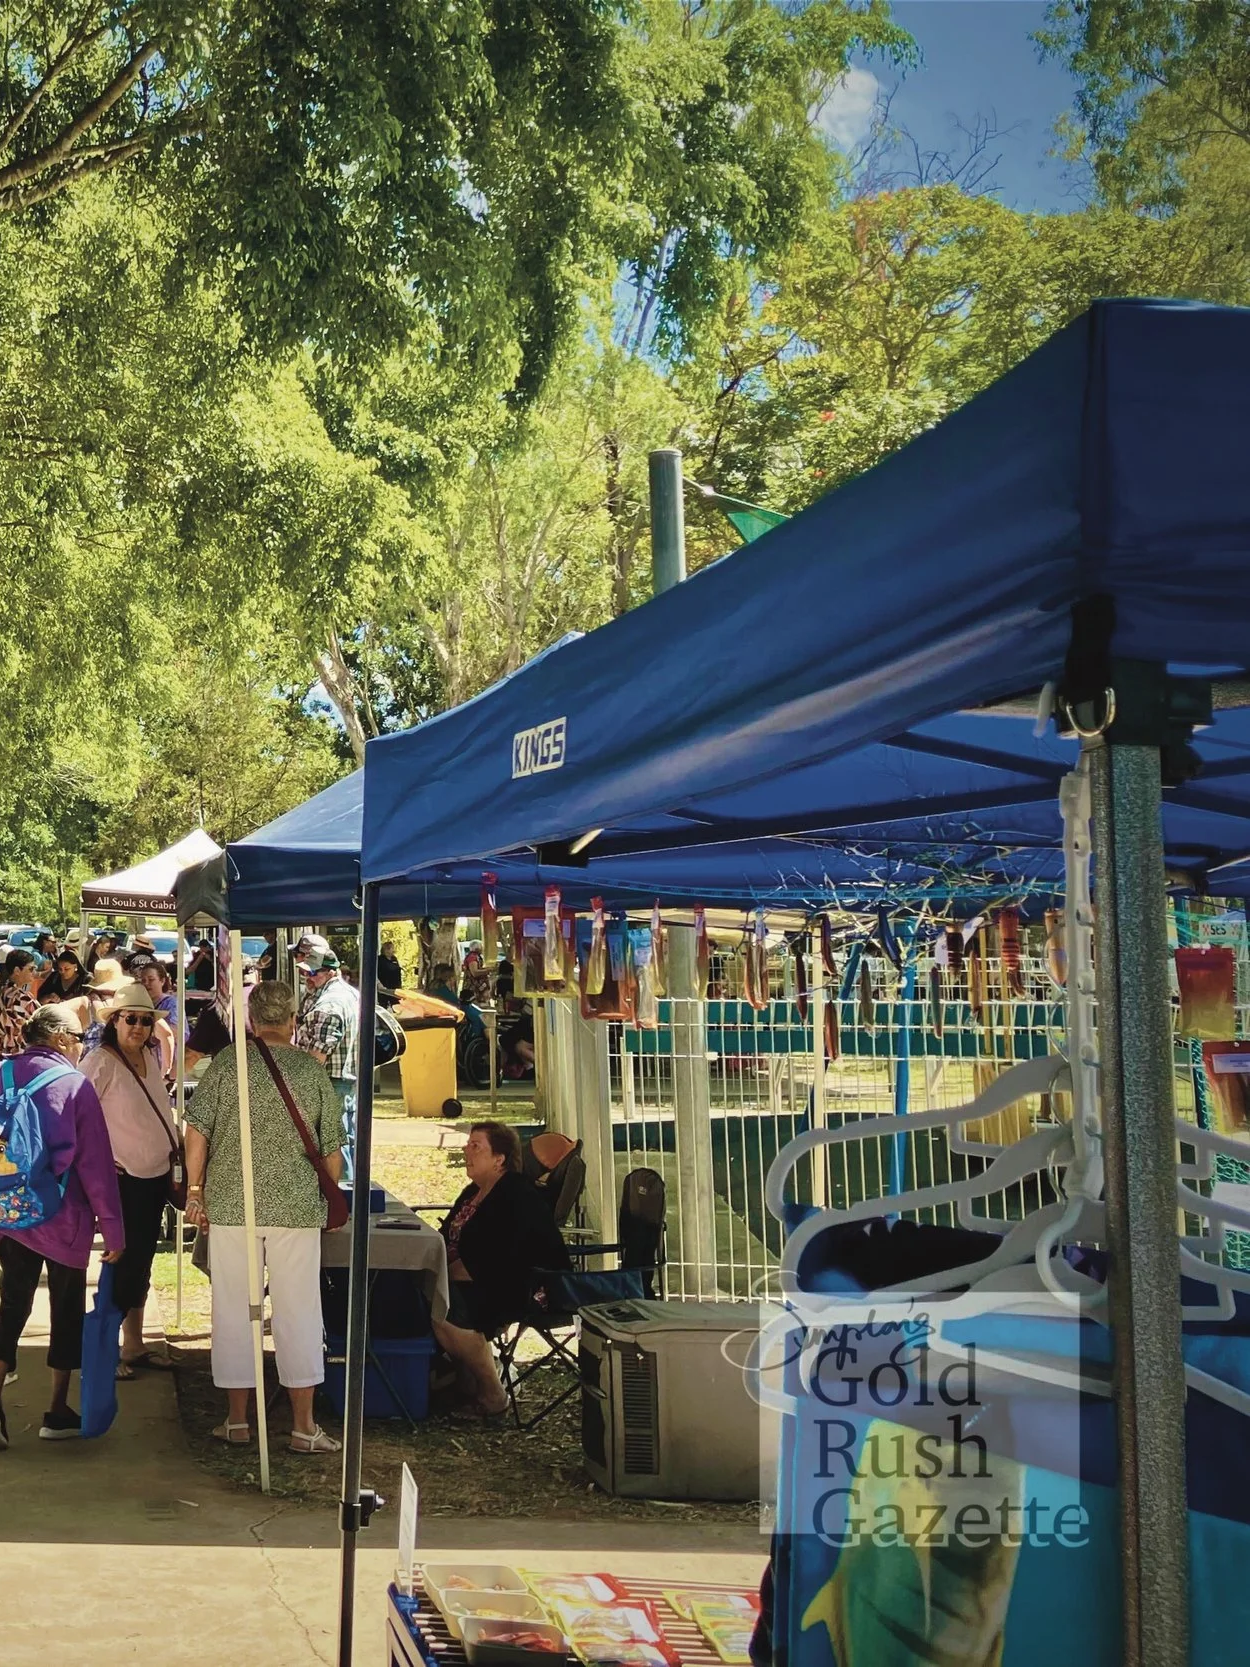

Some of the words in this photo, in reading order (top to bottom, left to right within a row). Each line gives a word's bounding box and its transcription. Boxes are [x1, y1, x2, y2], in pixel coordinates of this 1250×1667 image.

[514, 723, 565, 775] KINGS
[95, 896, 110, 906] All
[112, 897, 136, 908] Souls
[138, 899, 148, 908] St
[150, 900, 177, 910] Gabri
